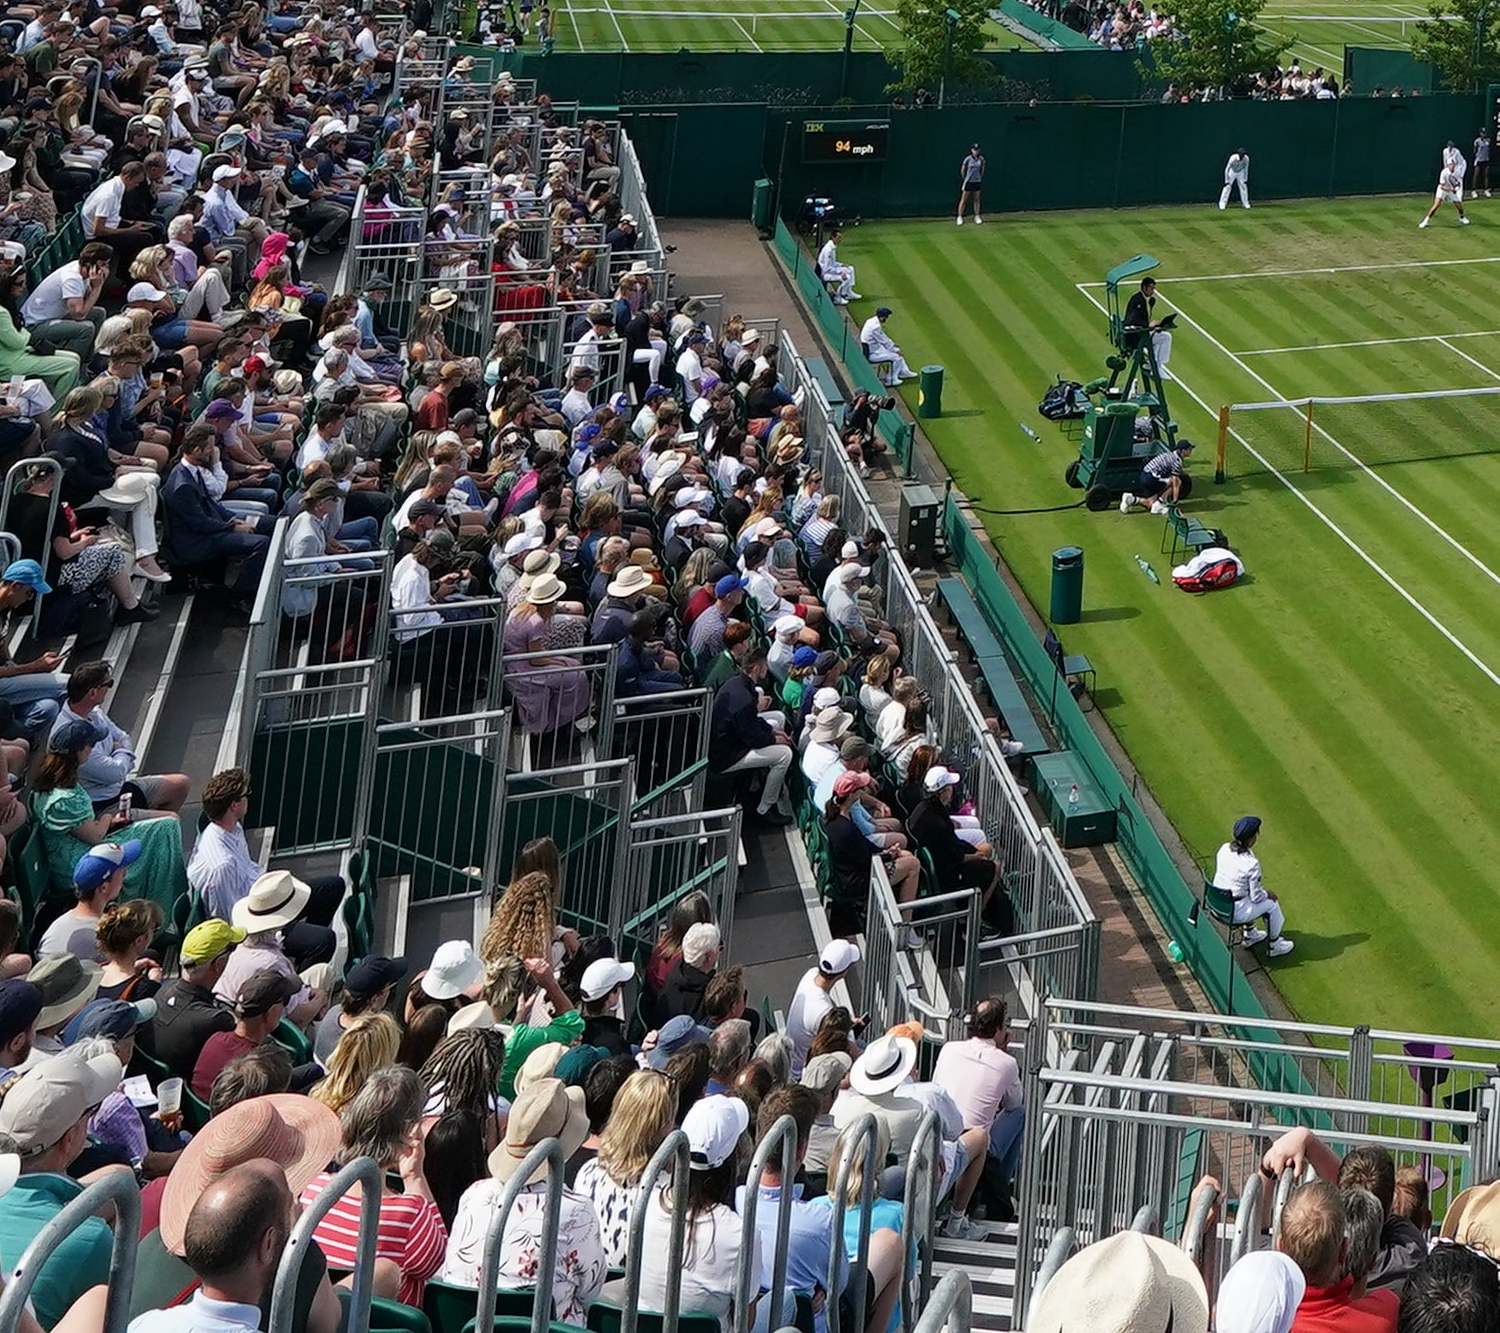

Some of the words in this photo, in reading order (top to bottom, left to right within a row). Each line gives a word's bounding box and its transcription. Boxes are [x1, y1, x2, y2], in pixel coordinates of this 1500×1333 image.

[805, 123, 825, 132] IBM
[835, 140, 851, 152] 94
[852, 144, 874, 155] mph
